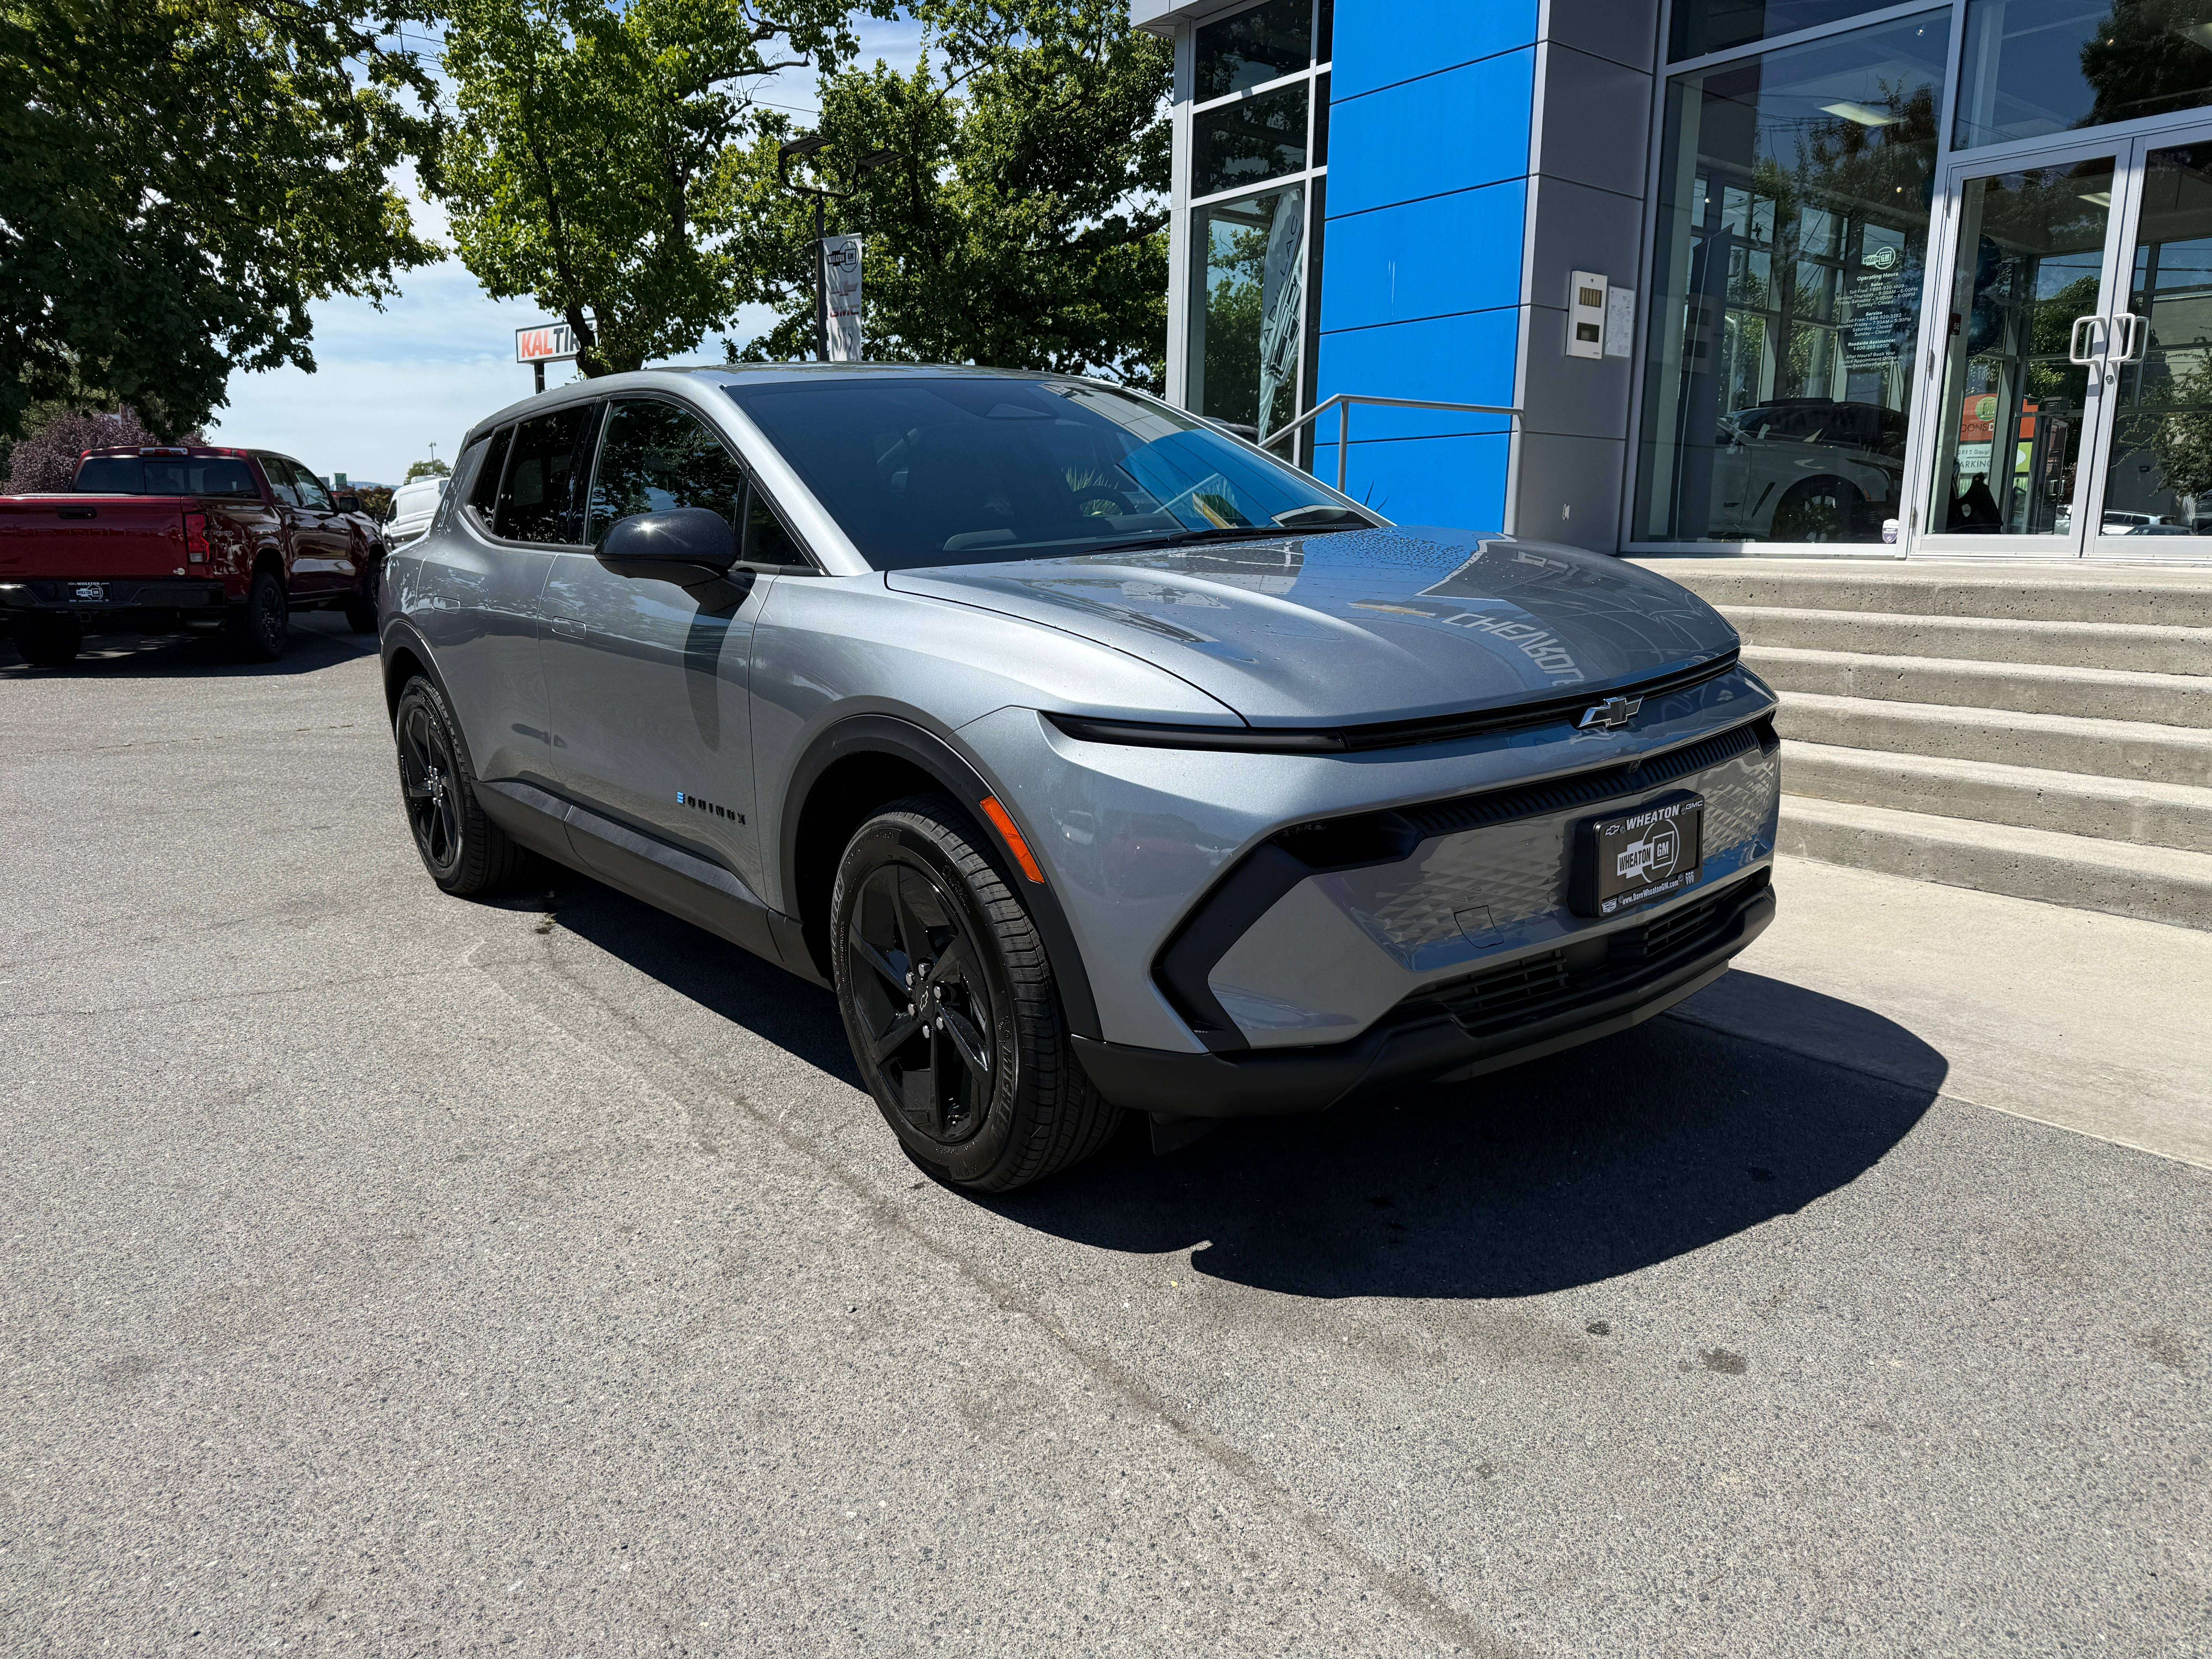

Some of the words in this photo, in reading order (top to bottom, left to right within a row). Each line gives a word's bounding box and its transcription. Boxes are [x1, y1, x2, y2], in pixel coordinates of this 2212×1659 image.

[1881, 253, 1890, 262] GM
[830, 304, 859, 318] GMC
[521, 330, 553, 358] KAL
[1960, 460, 1990, 468] ARKIN
[677, 791, 746, 825] EQUINOX
[1626, 804, 1680, 831] WHEATON
[1686, 800, 1704, 810] GMC
[1657, 841, 1669, 857] GM
[1620, 847, 1651, 872] WHEATON
